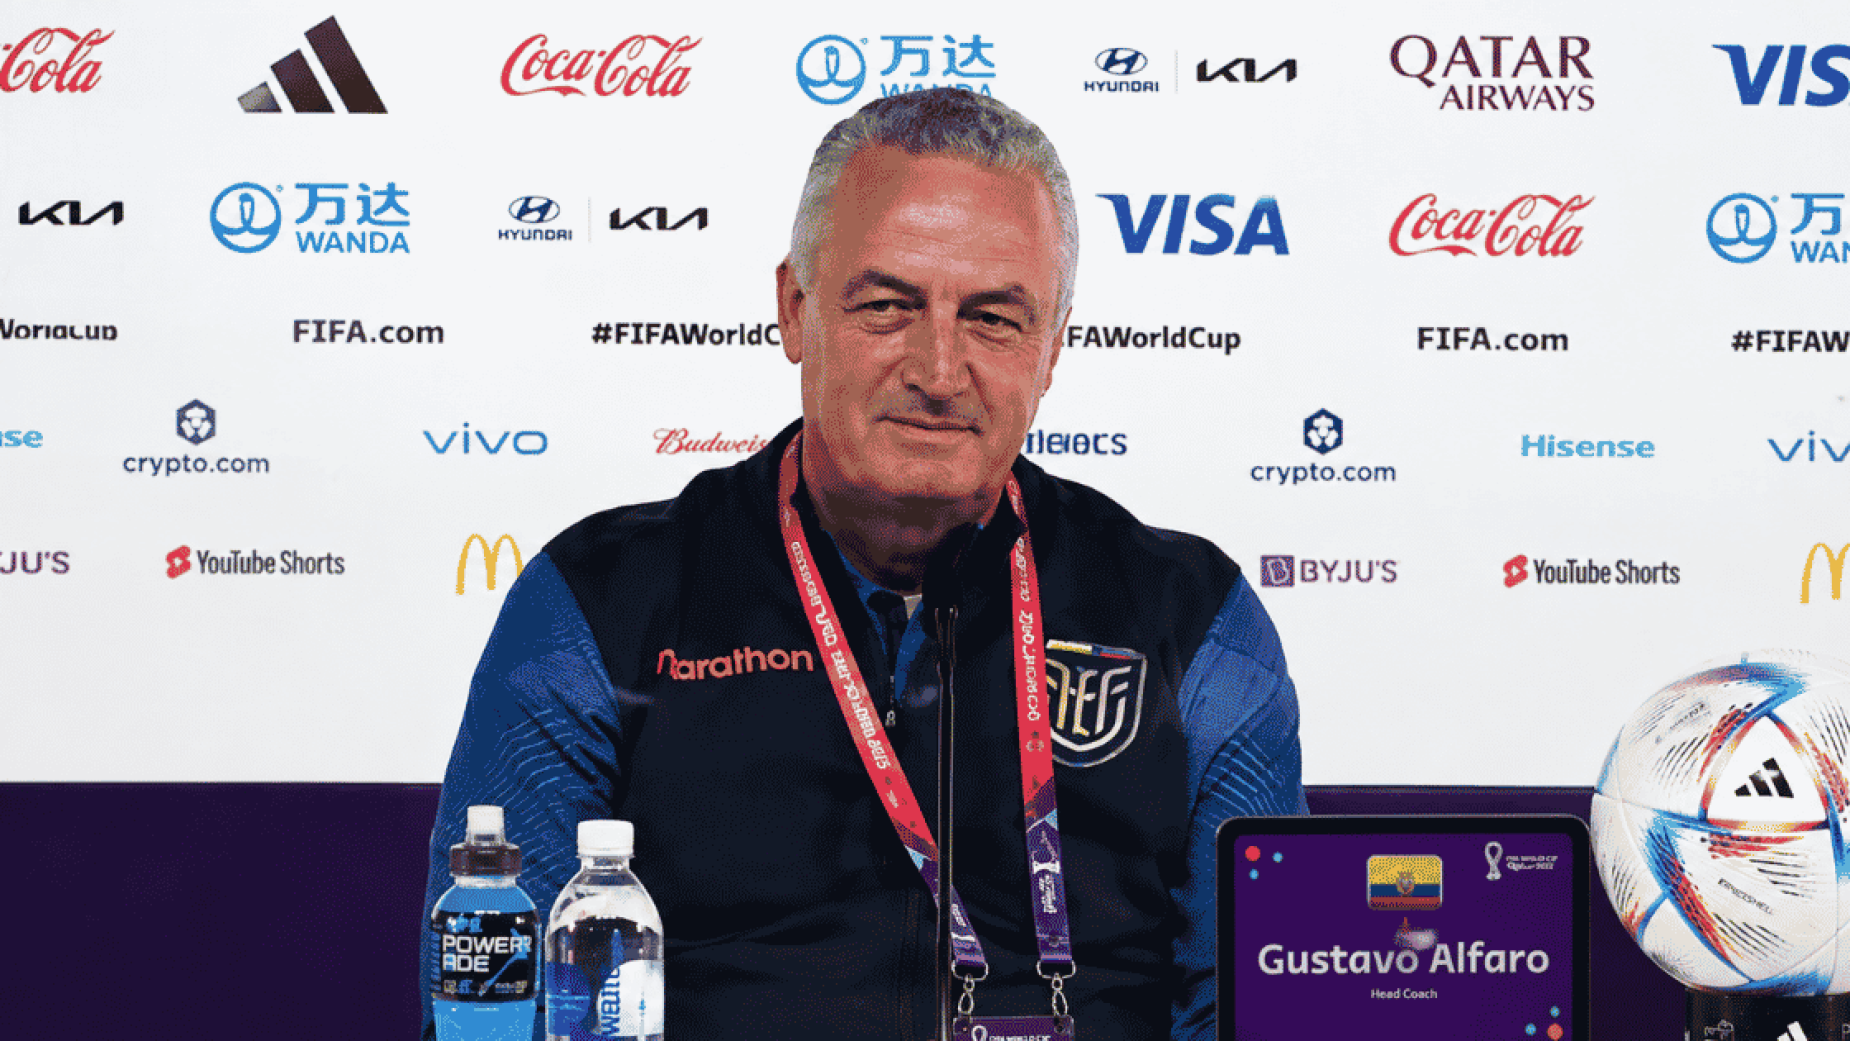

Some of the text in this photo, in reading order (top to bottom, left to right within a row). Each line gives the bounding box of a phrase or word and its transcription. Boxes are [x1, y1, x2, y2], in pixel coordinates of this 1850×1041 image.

[880, 34, 997, 78] 万达
[1389, 34, 1594, 88] QATAR
[1083, 80, 1160, 93] HYUNDAI
[1439, 84, 1596, 112] AIRWAYS
[294, 182, 411, 227] 万达
[498, 228, 574, 242] HYUNDAI
[1095, 193, 1291, 256] VISA
[295, 231, 411, 254] WANDA
[293, 319, 445, 345] FIFA.com
[591, 322, 780, 347] #FIFAWorldC
[1062, 324, 1242, 356] FAWorldCup
[1417, 327, 1569, 352] FIFA.com
[423, 421, 549, 456] vivo
[653, 427, 770, 455] Budweis
[1521, 433, 1656, 459] Hisense
[122, 453, 271, 478] crypto.com
[1250, 462, 1397, 486] crypto.com
[0, 550, 71, 575] JU'S
[196, 547, 346, 576] YouTube Shorts
[1300, 559, 1398, 584] BYJU'S
[1533, 557, 1681, 586] YouTube Shorts
[1258, 939, 1550, 974] Gustavo Alfaro
[1370, 987, 1438, 1000] Head Coach
